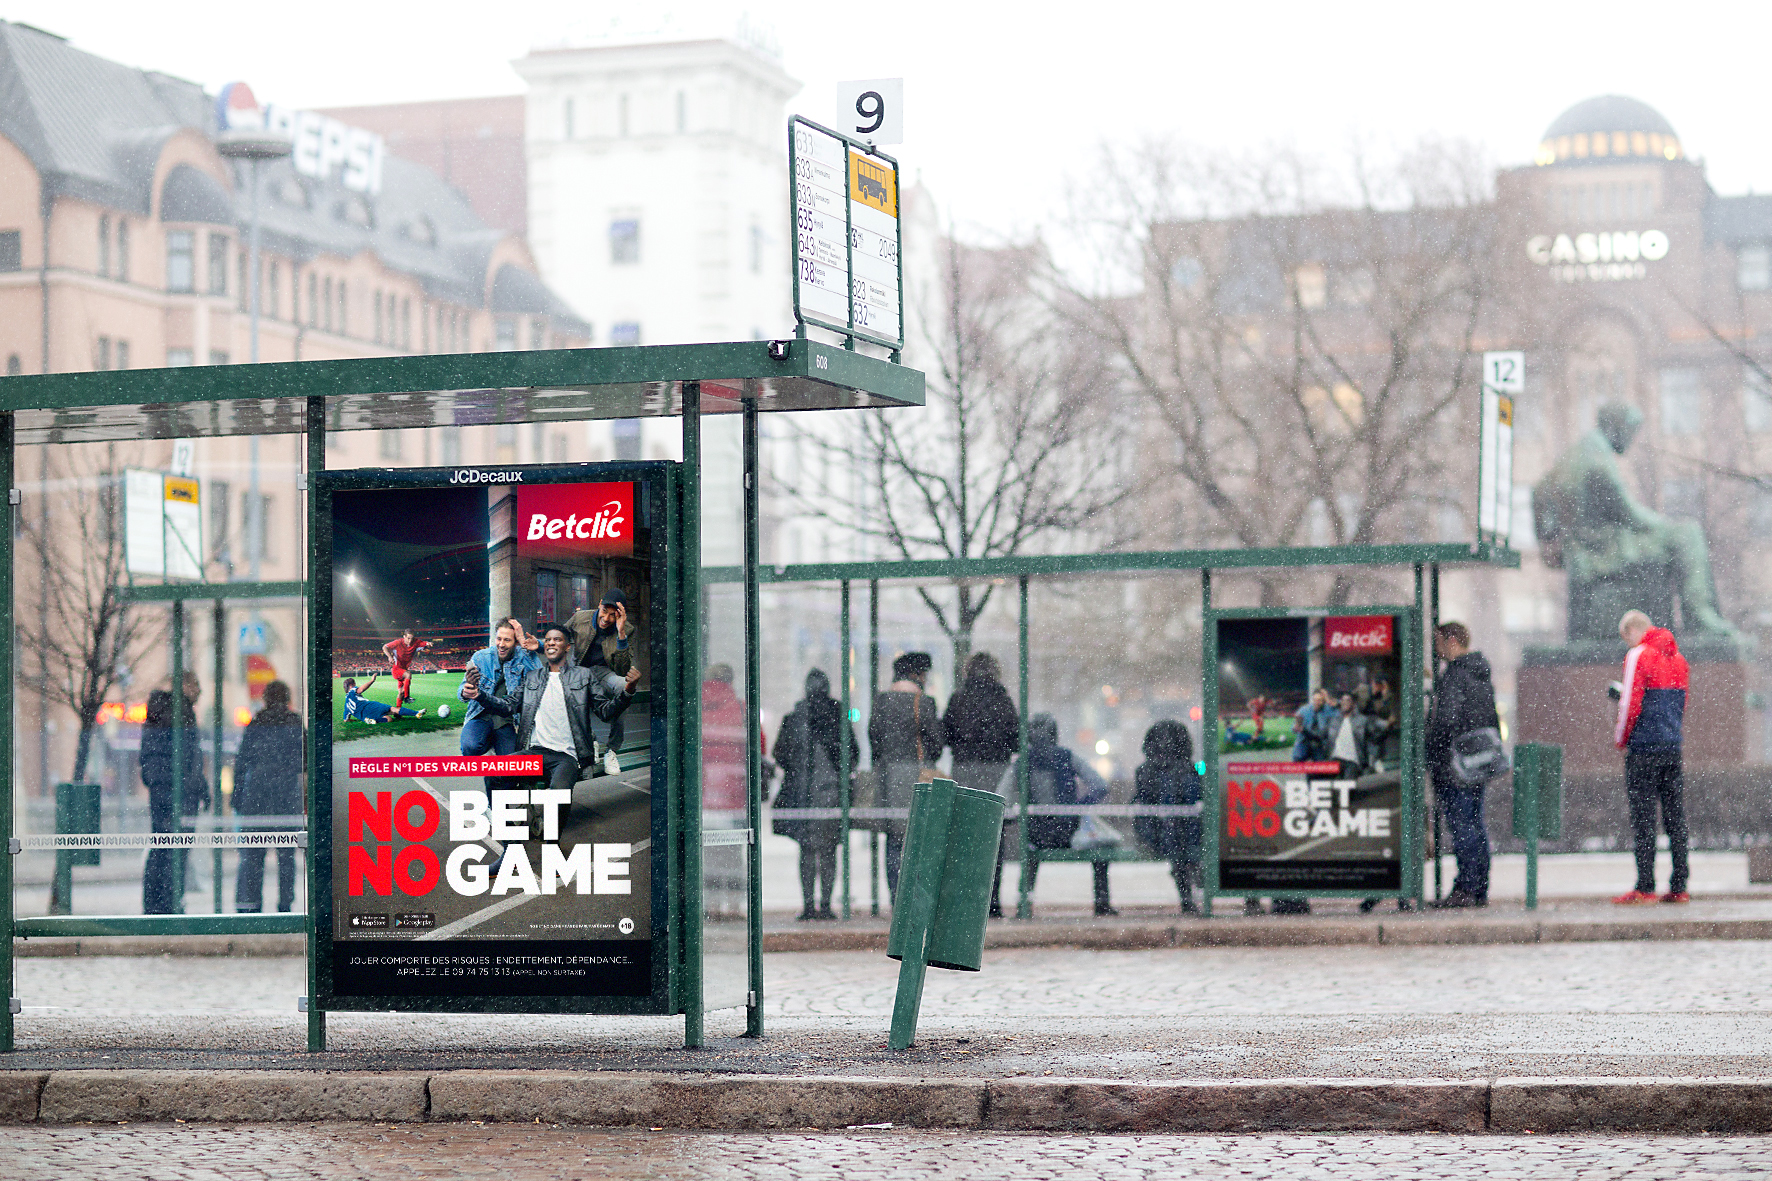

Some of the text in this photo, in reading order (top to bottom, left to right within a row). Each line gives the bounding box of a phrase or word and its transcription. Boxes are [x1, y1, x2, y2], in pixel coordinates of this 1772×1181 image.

[855, 90, 885, 134] 9
[263, 102, 384, 197] PEPSI
[798, 207, 814, 232] 635
[879, 238, 896, 262] 2049
[1526, 229, 1669, 266] CASINO
[799, 257, 815, 283] 738
[852, 278, 866, 300] 623
[853, 302, 868, 325] 632
[816, 354, 828, 370] 608
[1493, 359, 1516, 383] 12
[449, 470, 523, 484] JCDecaux
[526, 500, 624, 541] Betclic
[1330, 625, 1388, 648] Betclic
[352, 760, 541, 774] RÈGLE N°1 DES VRAIS PARIEURS
[1227, 779, 1356, 809] NO BET
[348, 788, 572, 843] NO BET
[1227, 808, 1391, 838] NO GAME
[348, 842, 632, 897] NO GAME
[620, 922, 633, 931] +18
[350, 956, 379, 965] JOUER
[380, 956, 431, 965] COMPORTE
[432, 956, 450, 965] DES
[451, 956, 490, 966] RISQUES
[496, 956, 564, 966] ENDETTEMENT,
[396, 967, 437, 977] APPELEZ
[439, 967, 450, 976] LE
[452, 967, 464, 976] 09
[466, 967, 477, 976] 74
[478, 967, 489, 976] 75
[490, 967, 500, 976] 13
[501, 967, 511, 976] 13
